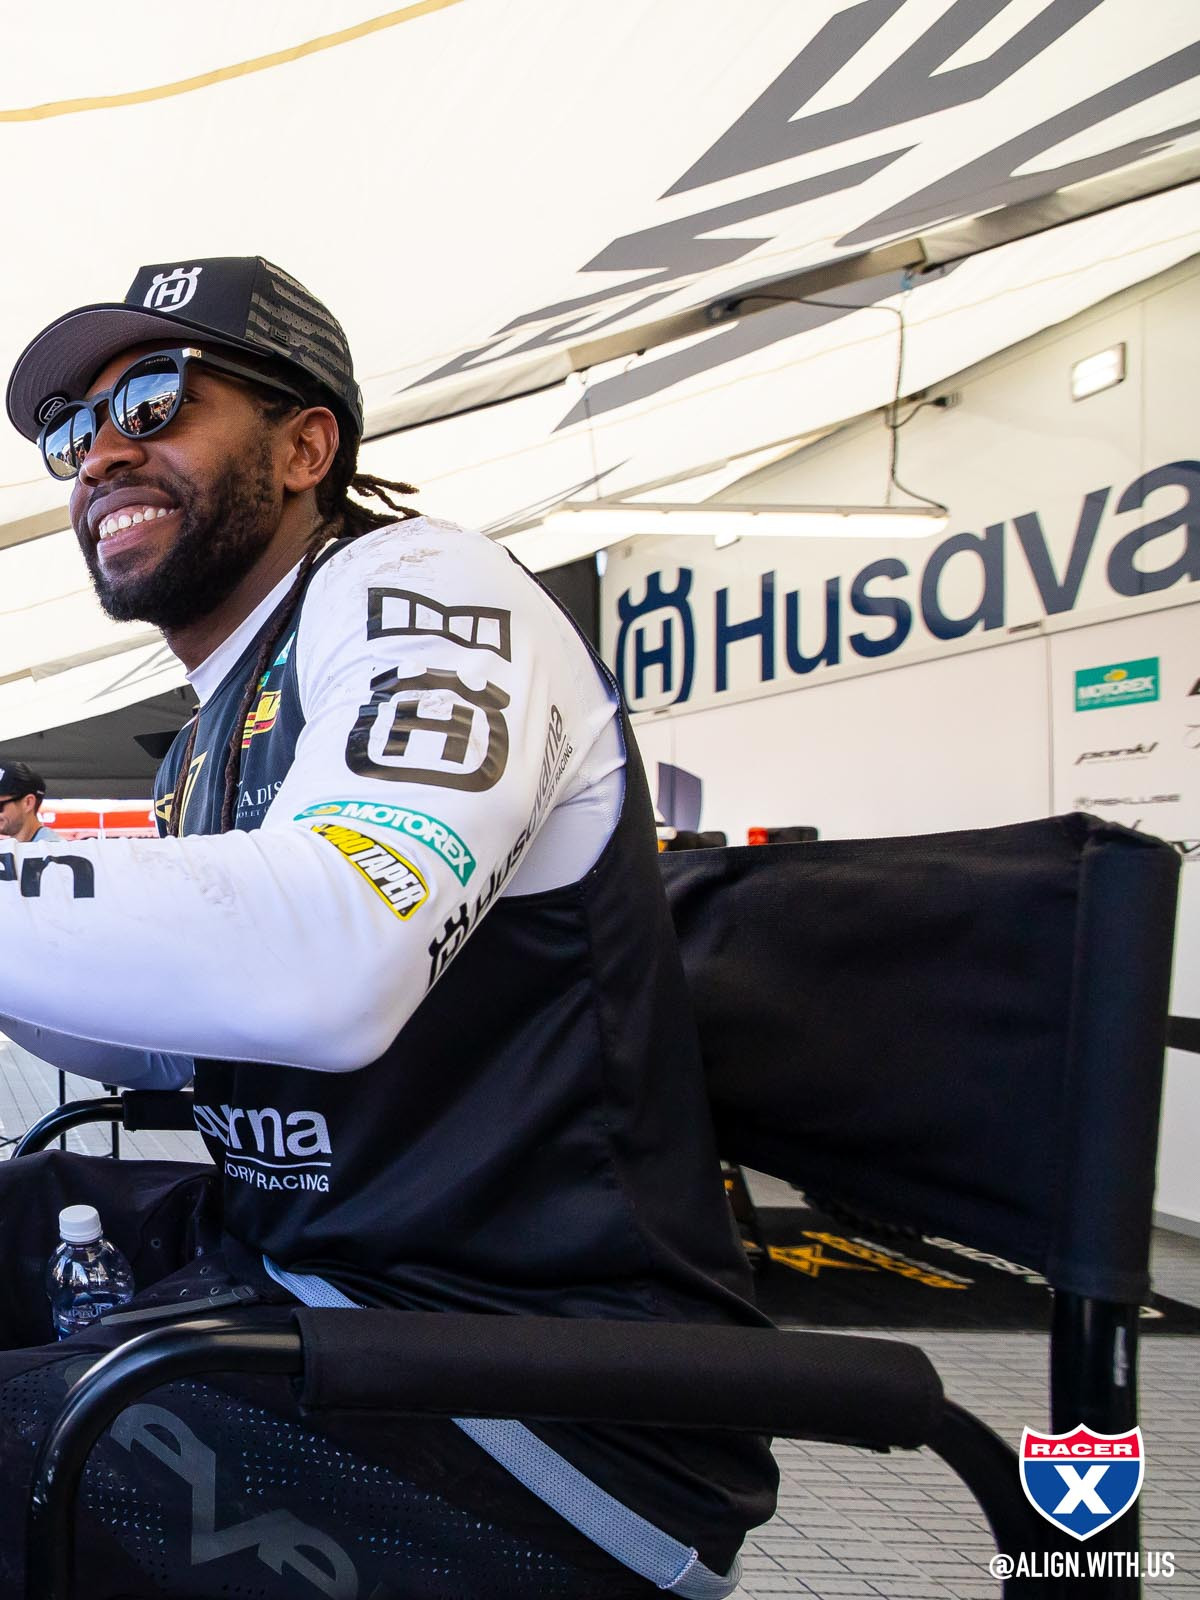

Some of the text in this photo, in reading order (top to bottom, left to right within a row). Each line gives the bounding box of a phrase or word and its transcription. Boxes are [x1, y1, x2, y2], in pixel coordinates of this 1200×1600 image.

[1077, 675, 1155, 700] MOTOREX
[341, 802, 473, 877] MOTOREX
[257, 1172, 330, 1193] RACING
